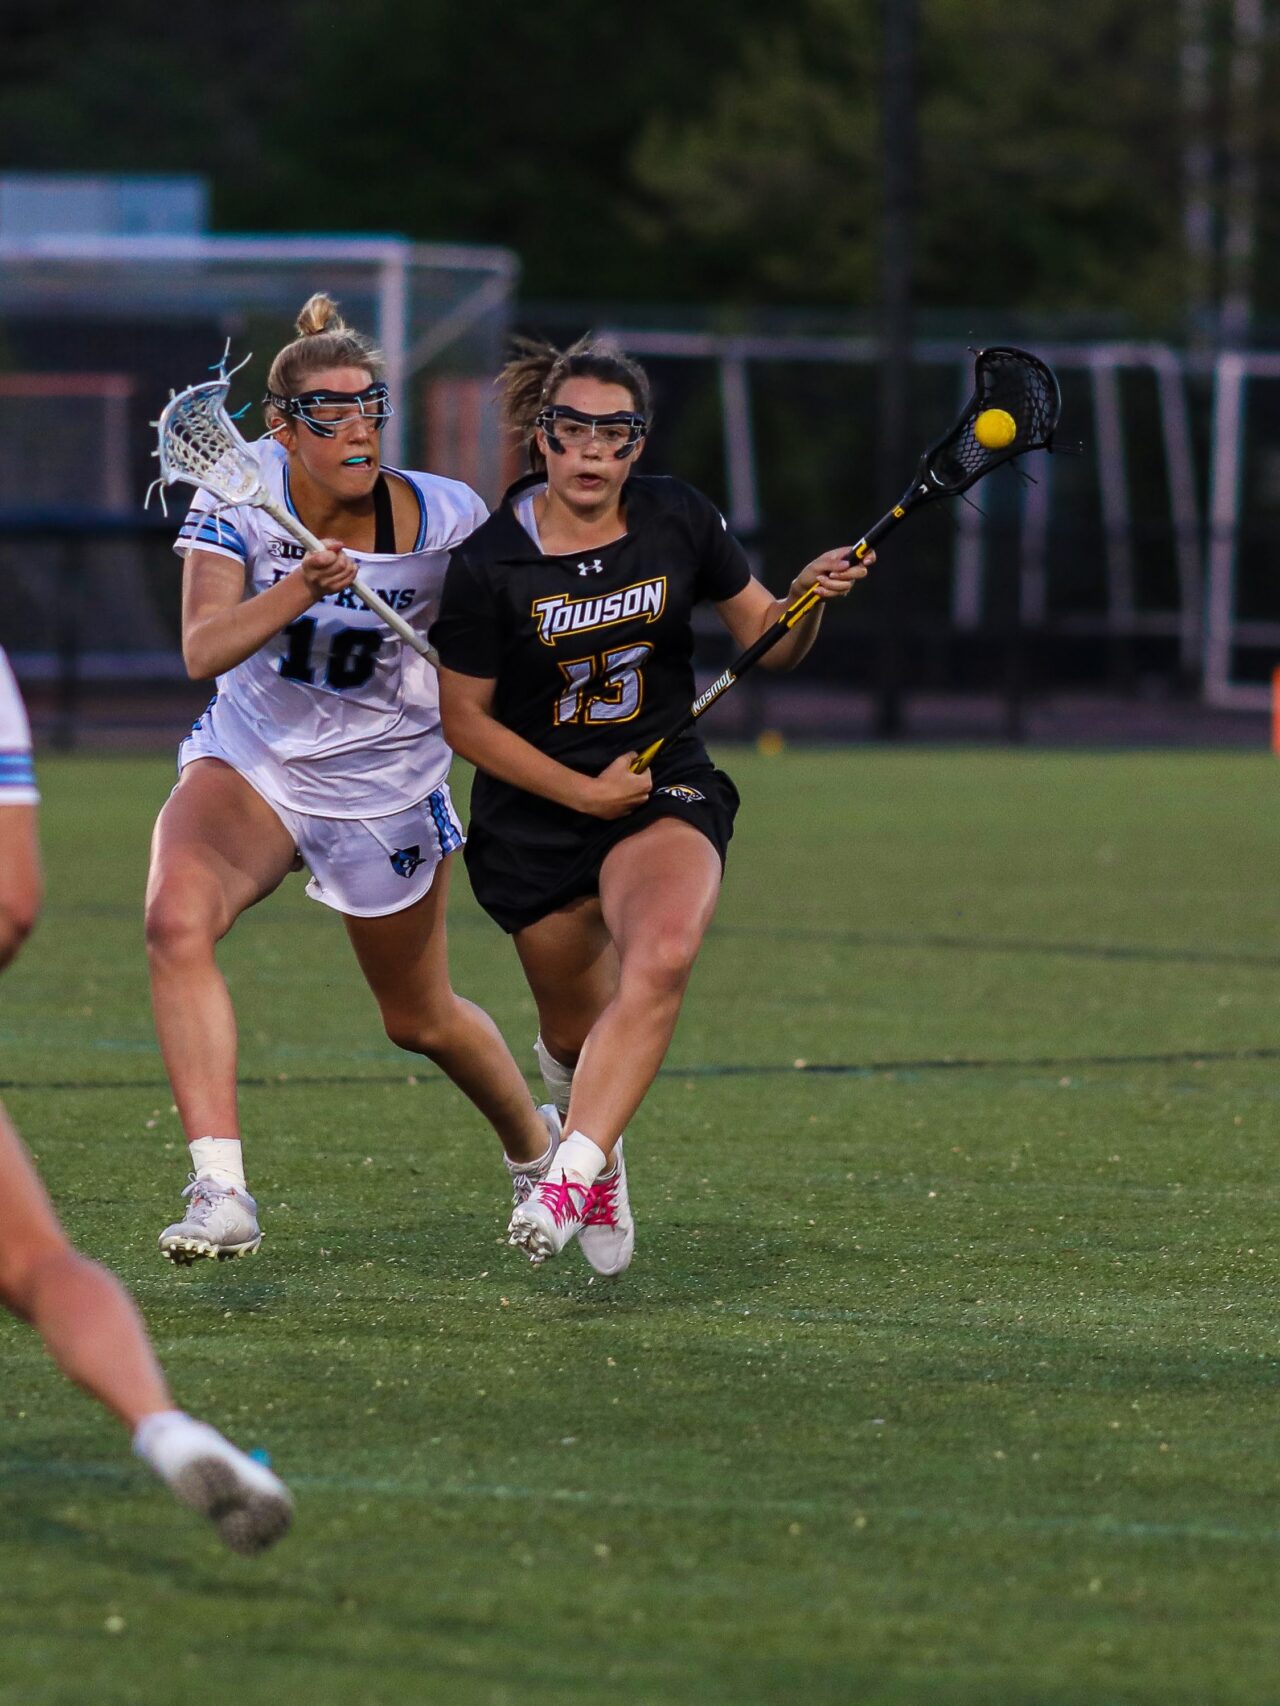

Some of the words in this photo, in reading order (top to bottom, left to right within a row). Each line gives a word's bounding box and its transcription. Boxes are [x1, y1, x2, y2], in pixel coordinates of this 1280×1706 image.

[534, 580, 664, 643] TOWSON
[555, 643, 654, 723] 13
[691, 668, 735, 714] TOWSON
